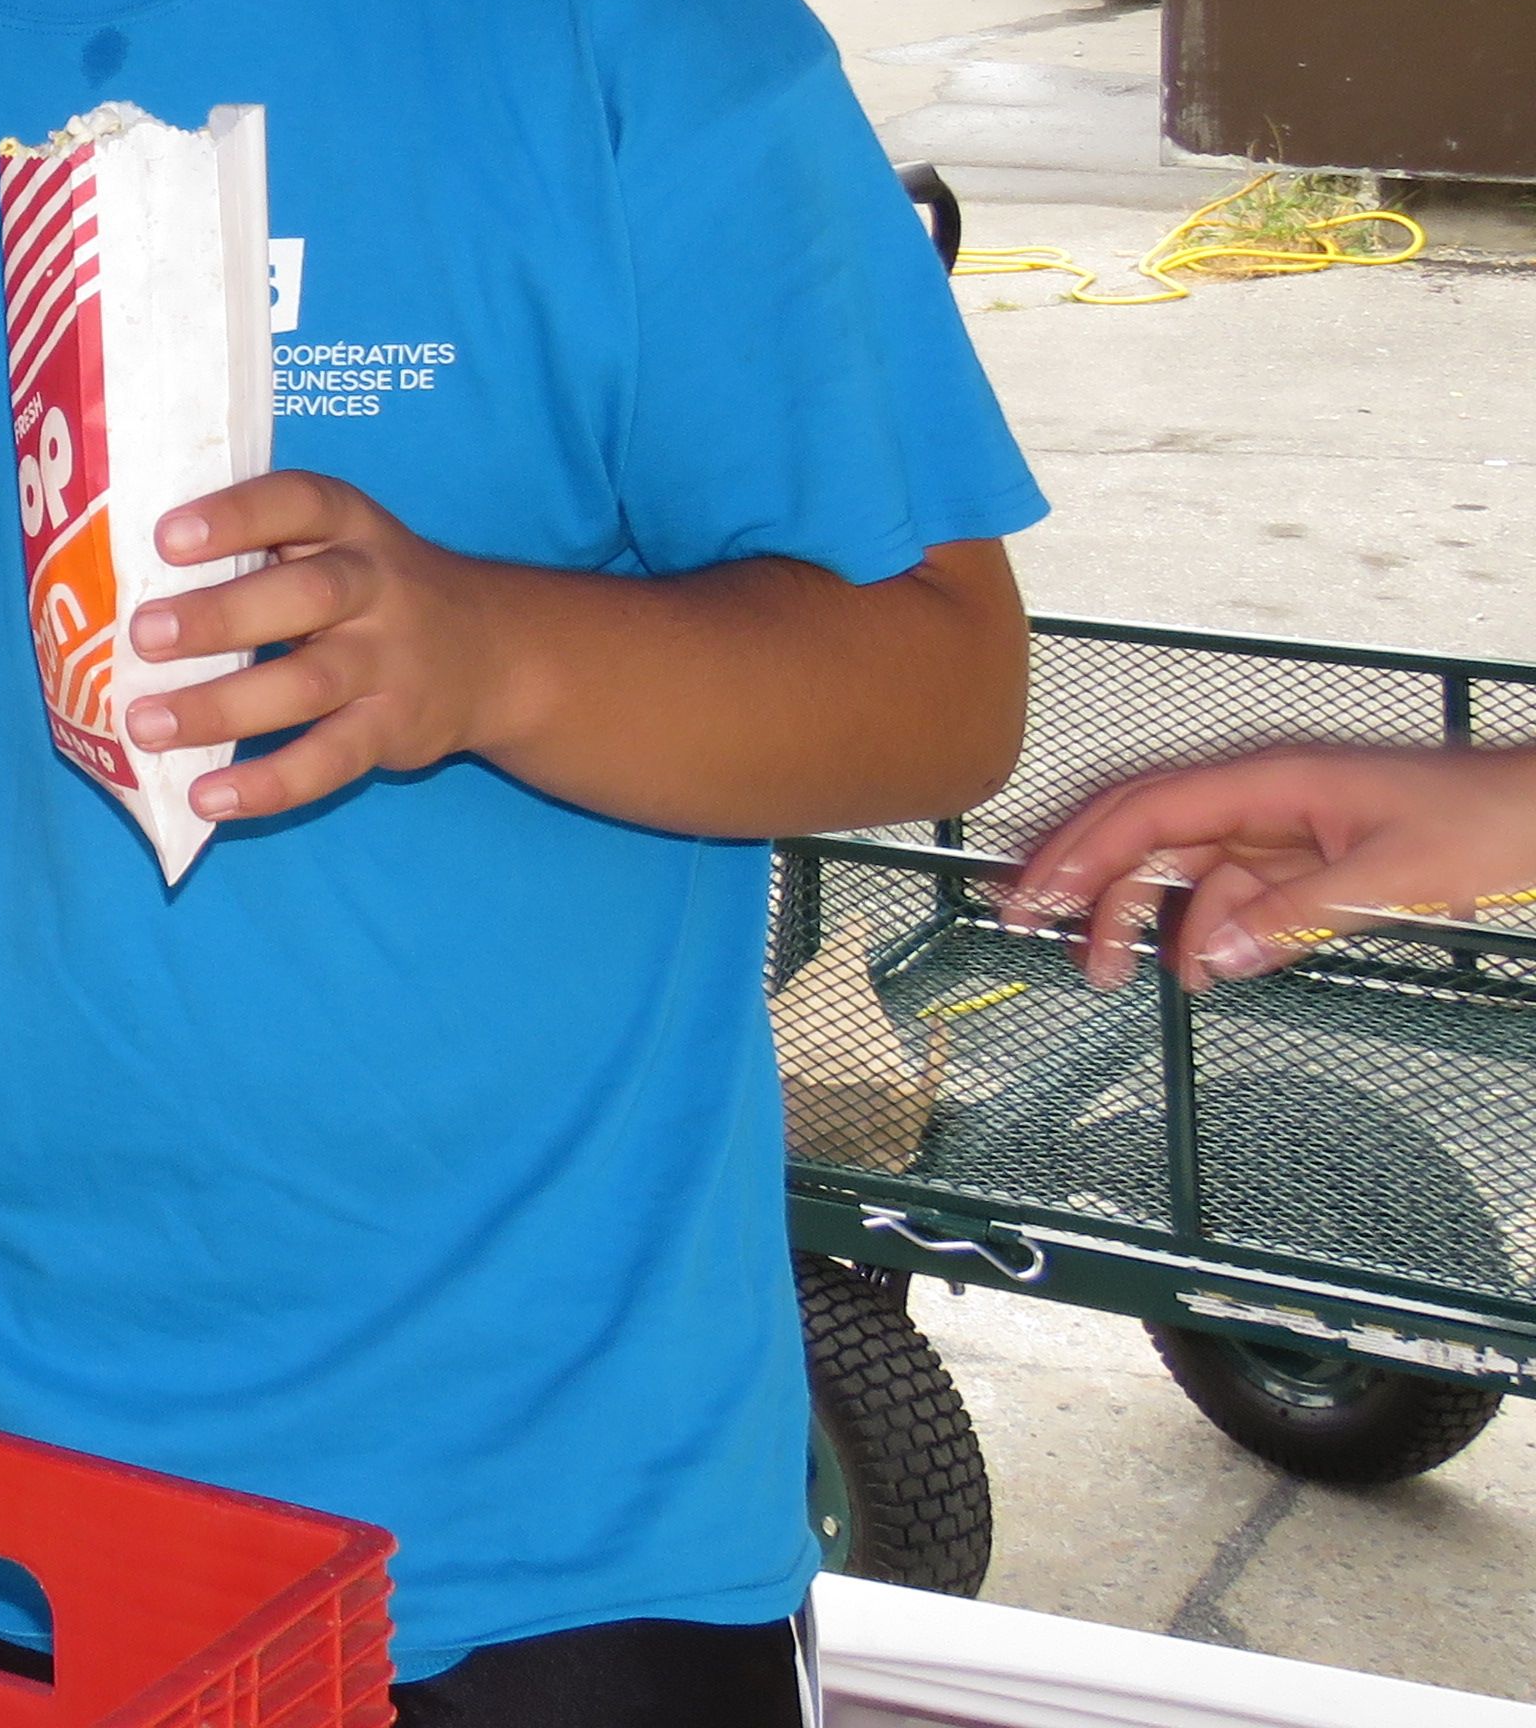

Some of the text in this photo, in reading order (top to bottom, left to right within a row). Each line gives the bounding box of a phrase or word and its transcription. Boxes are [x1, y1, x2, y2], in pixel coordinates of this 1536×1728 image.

[273, 340, 455, 366] OOPÉRATIVES
[272, 369, 434, 391] EUNESSE DE
[14, 391, 43, 445] FRESH
[272, 395, 379, 417] ERVICES
[19, 406, 72, 537] op
